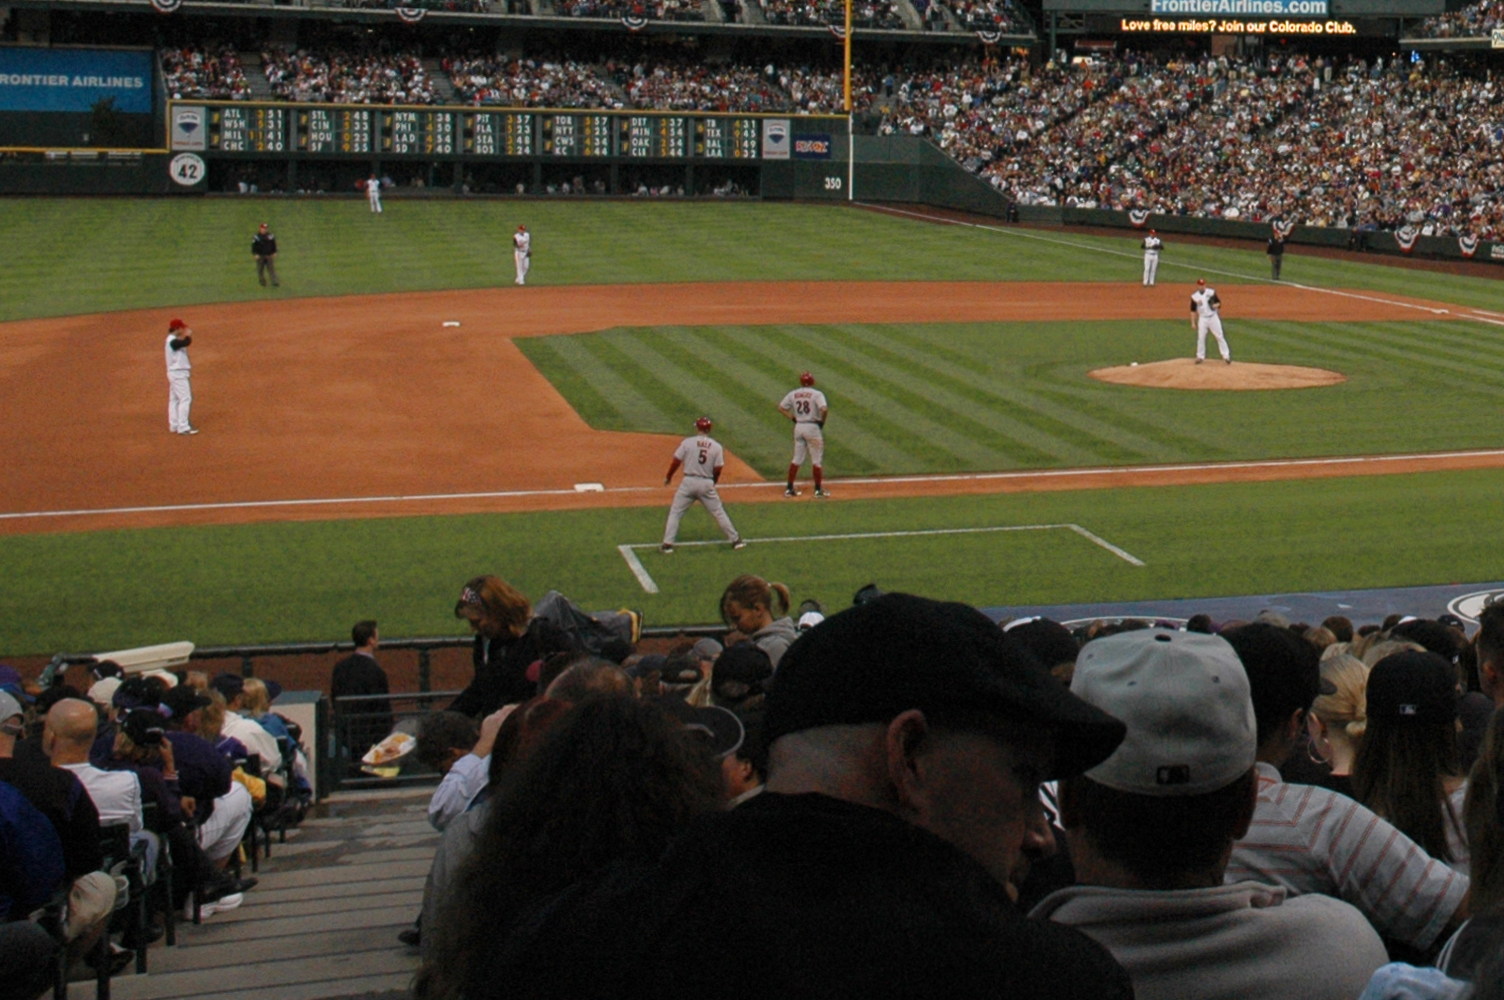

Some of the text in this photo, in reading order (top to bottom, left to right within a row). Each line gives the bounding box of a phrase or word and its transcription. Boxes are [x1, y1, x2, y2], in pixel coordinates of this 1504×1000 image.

[1122, 19, 1357, 33] Love free miles? Join our Colorado Club.
[72, 75, 143, 88] AIRLINES
[224, 109, 240, 118] ATL
[312, 110, 327, 119] STL
[396, 112, 416, 122] NYM
[476, 114, 490, 123] PIT
[556, 116, 572, 125] TOR
[224, 120, 246, 129] WSH
[311, 121, 329, 130] CIN
[396, 123, 411, 132] PHI
[706, 119, 716, 128] TB
[476, 124, 492, 133] FLA
[632, 128, 650, 136] MIN
[706, 129, 721, 137] TEX
[224, 131, 242, 139] MIL
[311, 132, 332, 141] HOU
[396, 134, 415, 142] LAD
[476, 135, 493, 144] SEA
[224, 142, 244, 150] CHC
[556, 137, 574, 146] CWS
[632, 138, 649, 147] OAK
[311, 142, 322, 151] SF
[396, 144, 408, 153] SD
[476, 145, 494, 154] BOS
[556, 147, 567, 155] KC
[706, 149, 723, 157] LAA
[178, 164, 197, 179] 42
[825, 177, 842, 189] 350
[796, 400, 811, 414] 28
[698, 449, 707, 465] 5
